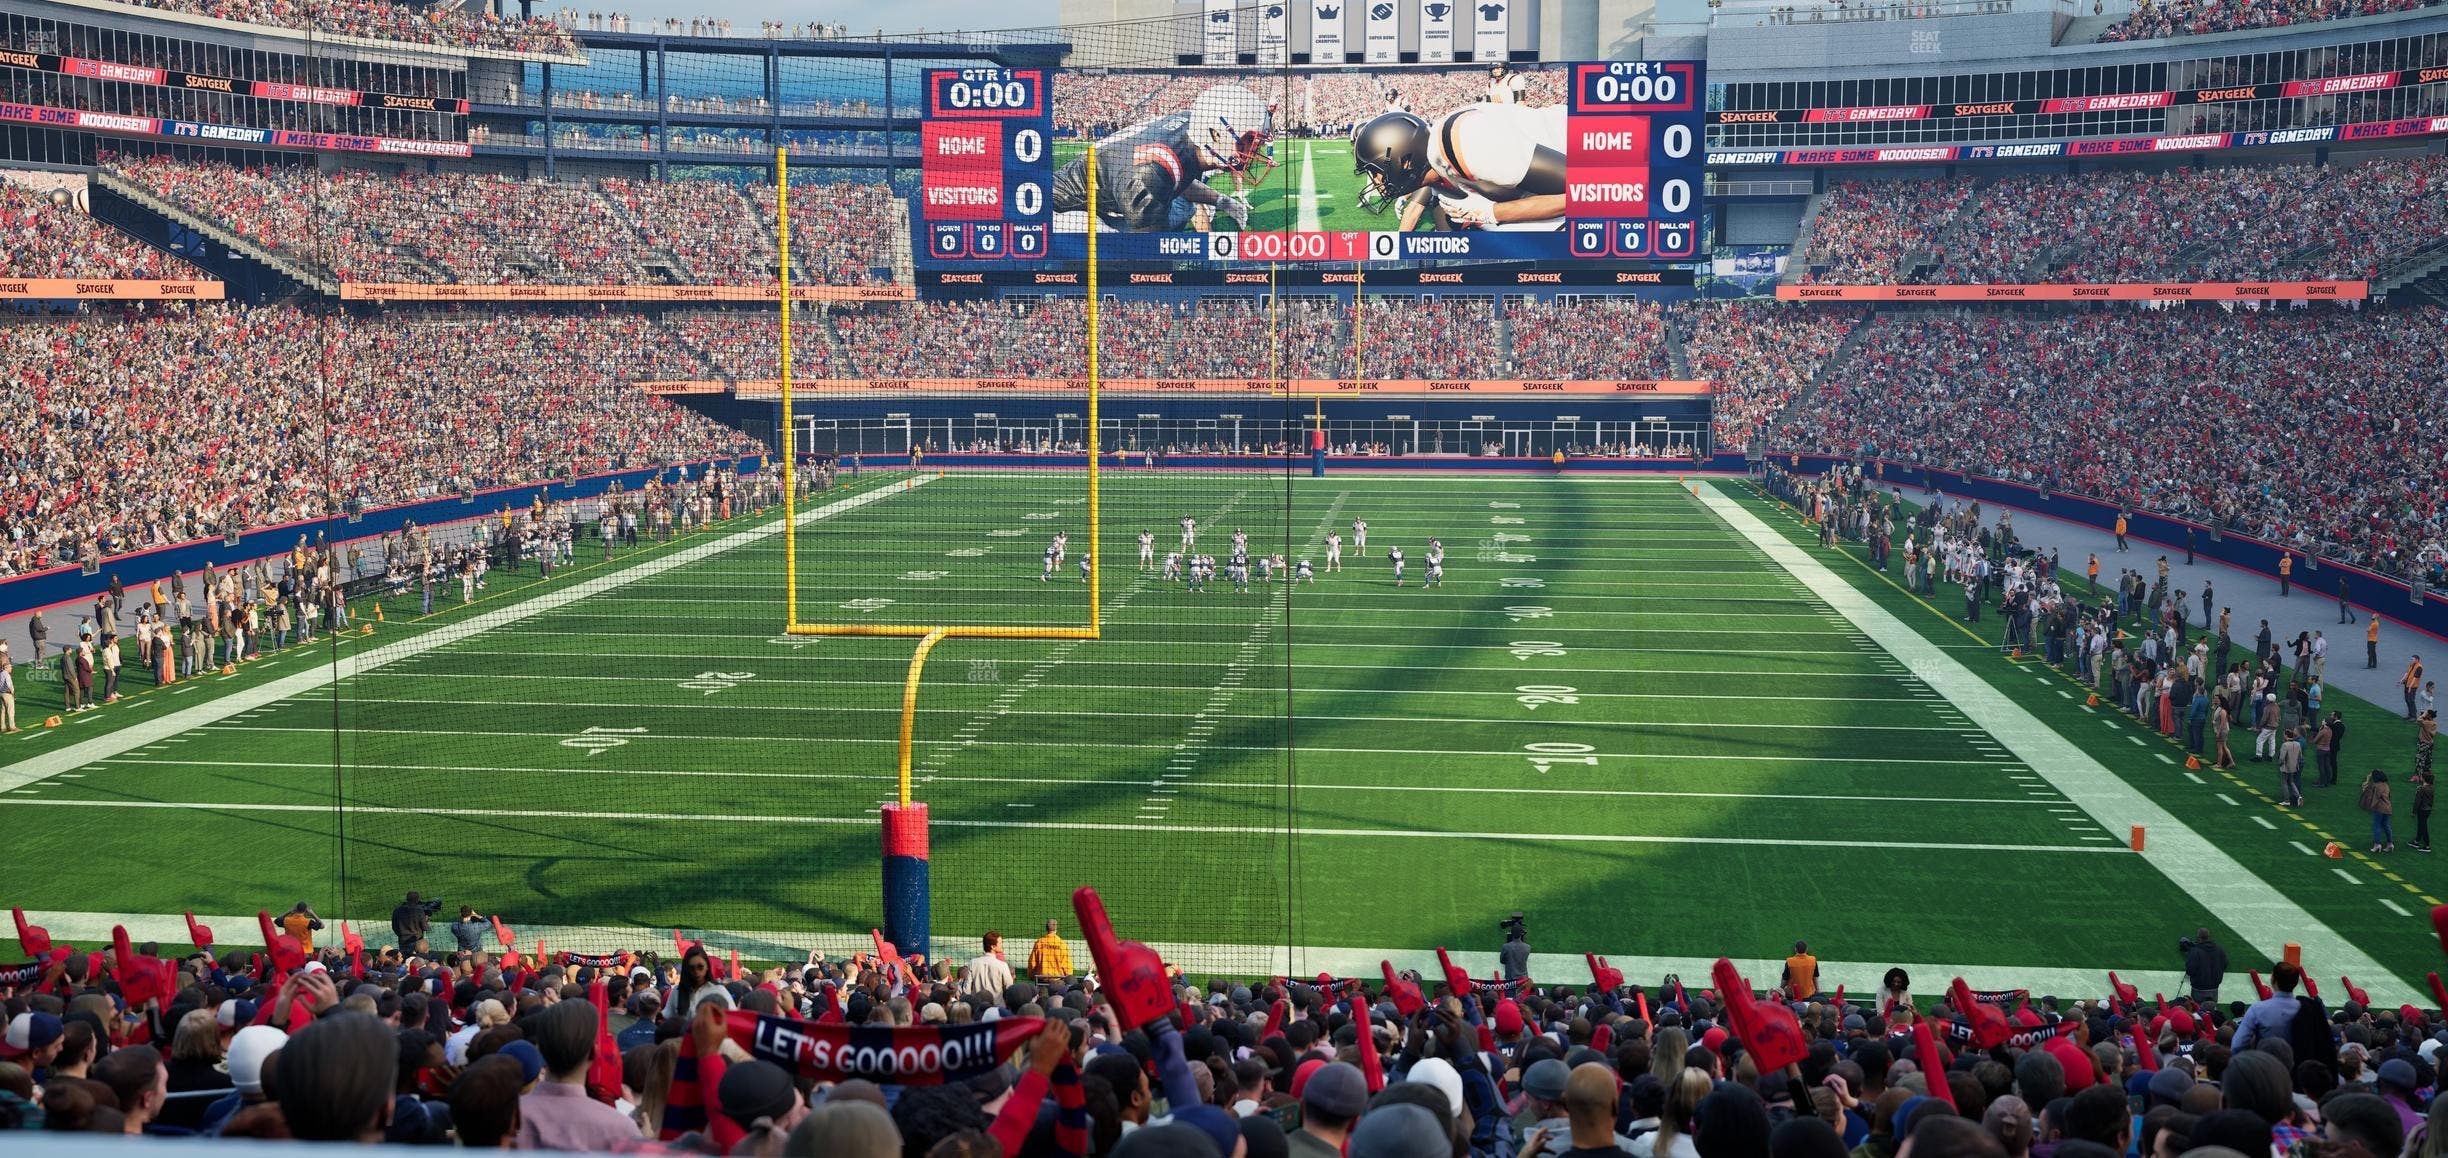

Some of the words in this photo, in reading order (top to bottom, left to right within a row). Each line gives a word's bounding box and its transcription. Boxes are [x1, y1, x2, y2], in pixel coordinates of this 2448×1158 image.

[77, 61, 97, 76] IT'S
[100, 64, 156, 82] GAMEDAY!
[962, 69, 998, 81] QTR
[1003, 69, 1011, 80] 1
[1610, 62, 1648, 75] QTR
[1653, 62, 1662, 74] 1
[185, 74, 232, 92] SEATGEEK
[1596, 75, 1676, 102] 0:00
[2298, 81, 2321, 95] IT'S
[2324, 74, 2389, 92] GAMEDAY!
[267, 84, 289, 97] IT'S
[950, 82, 1025, 108] 0:00
[2197, 86, 2256, 102] SEATGEEK
[383, 95, 436, 111] SEATGEEK
[2059, 99, 2085, 111] IT'S
[2089, 94, 2163, 109] GAMEDAY!
[1823, 110, 1847, 121] IT'S
[1850, 107, 1917, 120] GAMEDAY!
[1955, 103, 2015, 116] SEATGEEK
[39, 109, 76, 124] SOME
[1719, 111, 1778, 123] SEATGEEK
[174, 122, 199, 136] IT'S
[201, 125, 265, 142] GAMEDAY!
[2352, 123, 2390, 137] MAKE
[2394, 120, 2428, 134] SOME
[286, 133, 329, 146] MAKE
[335, 137, 374, 150] SOME
[1583, 131, 1632, 151] HOME
[1663, 124, 1692, 158] 0
[2243, 132, 2268, 146] IT'S
[2270, 128, 2334, 144] GAMEDAY!
[939, 136, 985, 154] HOME
[1015, 129, 1042, 163] 0
[1970, 146, 1994, 158] IT'S
[1997, 144, 2061, 157] GAMEDAY!
[2078, 141, 2118, 153] MAKE
[2118, 140, 2153, 151] SOME
[1707, 152, 1777, 164] GAMEDAY!
[1797, 152, 1836, 163] MAKE
[1841, 150, 1876, 161] SOME
[928, 186, 999, 205] VISITORS
[1016, 182, 1043, 216] 0
[1569, 183, 1644, 202] VISITORS
[1662, 179, 1691, 213] 0
[1341, 232, 1358, 240] QRT
[1583, 232, 1598, 250] 0
[1624, 232, 1640, 250] 0
[1666, 232, 1682, 250] 0
[942, 235, 956, 251] 0
[981, 235, 995, 251] 0
[1021, 235, 1035, 251] 0
[1160, 238, 1201, 254] HOME
[1214, 235, 1232, 256] 0
[1244, 234, 1325, 257] 00:00
[1346, 242, 1353, 256] 1
[1375, 234, 1394, 256] 0
[1406, 237, 1470, 254] VISITORS
[941, 274, 983, 283] SEATGEEK
[1035, 273, 1078, 283] SEATGEEK
[1130, 273, 1173, 283] SEATGEEK
[1225, 273, 1269, 283] SEATGEEK
[1322, 273, 1366, 283] SEATGEEK
[1419, 273, 1463, 283] SEATGEEK
[1517, 273, 1562, 283] SEATGEEK
[1616, 272, 1661, 283] SEATGEEK
[76, 283, 114, 294] SEATGEEK
[160, 284, 196, 295] SEATGEEK
[365, 287, 397, 296] SEATGEEK
[435, 287, 468, 296] SEATGEEK
[510, 288, 547, 297] SEATGEEK
[588, 288, 626, 297] SEATGEEK
[674, 289, 714, 297] SEATGEEK
[765, 289, 806, 297] SEAEEK
[860, 289, 904, 298] SEATGEEK
[1800, 288, 1842, 297] SEATGEEK
[1896, 288, 1937, 297] SEATGEEK
[1986, 288, 2025, 297] SEATGEEK
[2073, 288, 2110, 296] SEATGEEK
[2153, 287, 2192, 296] SEATGEEK
[2235, 286, 2270, 296] SEATGEEK
[2306, 286, 2337, 295] SEATGEEK
[650, 384, 688, 392] SEATGEEK
[777, 382, 817, 390] STGEEK
[869, 381, 910, 389] SEATGEEK
[977, 381, 1017, 389] SEATGEEK
[1156, 381, 1196, 389] SEATGEEK
[1430, 382, 1471, 391] SEATGEEK
[1523, 382, 1564, 391] SEATGEEK
[1616, 382, 1658, 391] SEATGEEK
[1508, 640, 1567, 656] 30
[1515, 685, 1580, 704] 20
[1524, 742, 1599, 765] 10
[569, 954, 586, 965] LET'S
[1951, 1023, 1972, 1042] LET
[755, 1020, 832, 1069] LET'S
[835, 1029, 994, 1075] GOOOOO!!!
